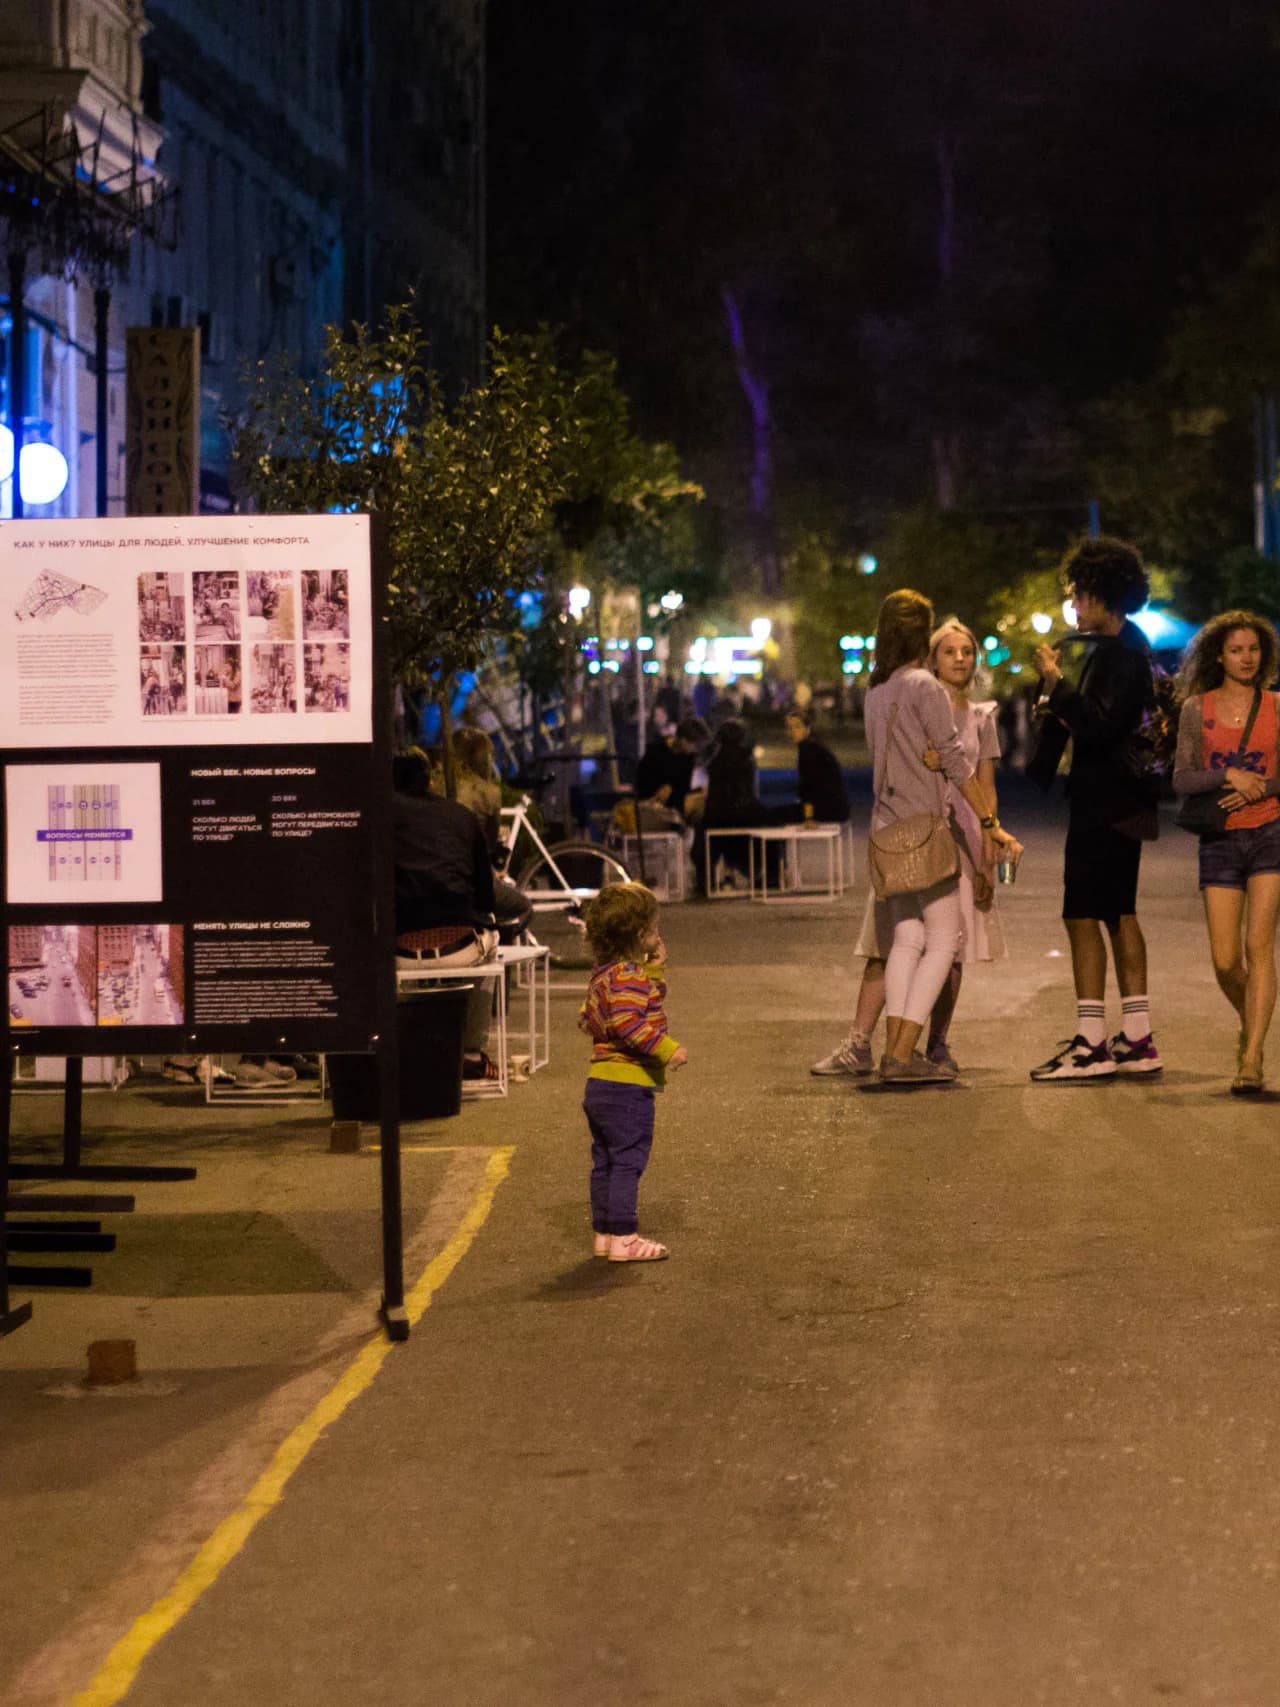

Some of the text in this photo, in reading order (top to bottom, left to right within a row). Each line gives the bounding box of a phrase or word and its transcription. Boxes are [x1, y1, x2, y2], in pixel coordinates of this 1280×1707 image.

[13, 540, 35, 549] КАК
[39, 540, 46, 549] У
[48, 539, 76, 549] НИХ?
[79, 538, 116, 549] УЛИЦЫ
[118, 538, 141, 548] ДЛЯ
[187, 537, 250, 546] УЛУЧШЕНИЕ
[252, 536, 311, 546] КОМФОРТА
[191, 767, 222, 777] НОВЫЙ
[243, 768, 273, 776] НОВЫЕ
[274, 767, 317, 776] ВОПРОСЫ
[283, 794, 297, 802] ВЕК
[192, 814, 256, 824] СКОЛЬКО ЛЮДЕЙ
[271, 812, 306, 820] СКОЛЬКО
[219, 824, 262, 832] ДВИГАТЬСЯ
[272, 830, 282, 838] ПО
[193, 920, 311, 931] МЕНЯТЬ УЛИЦЫ НЕ СЛОЖНО
